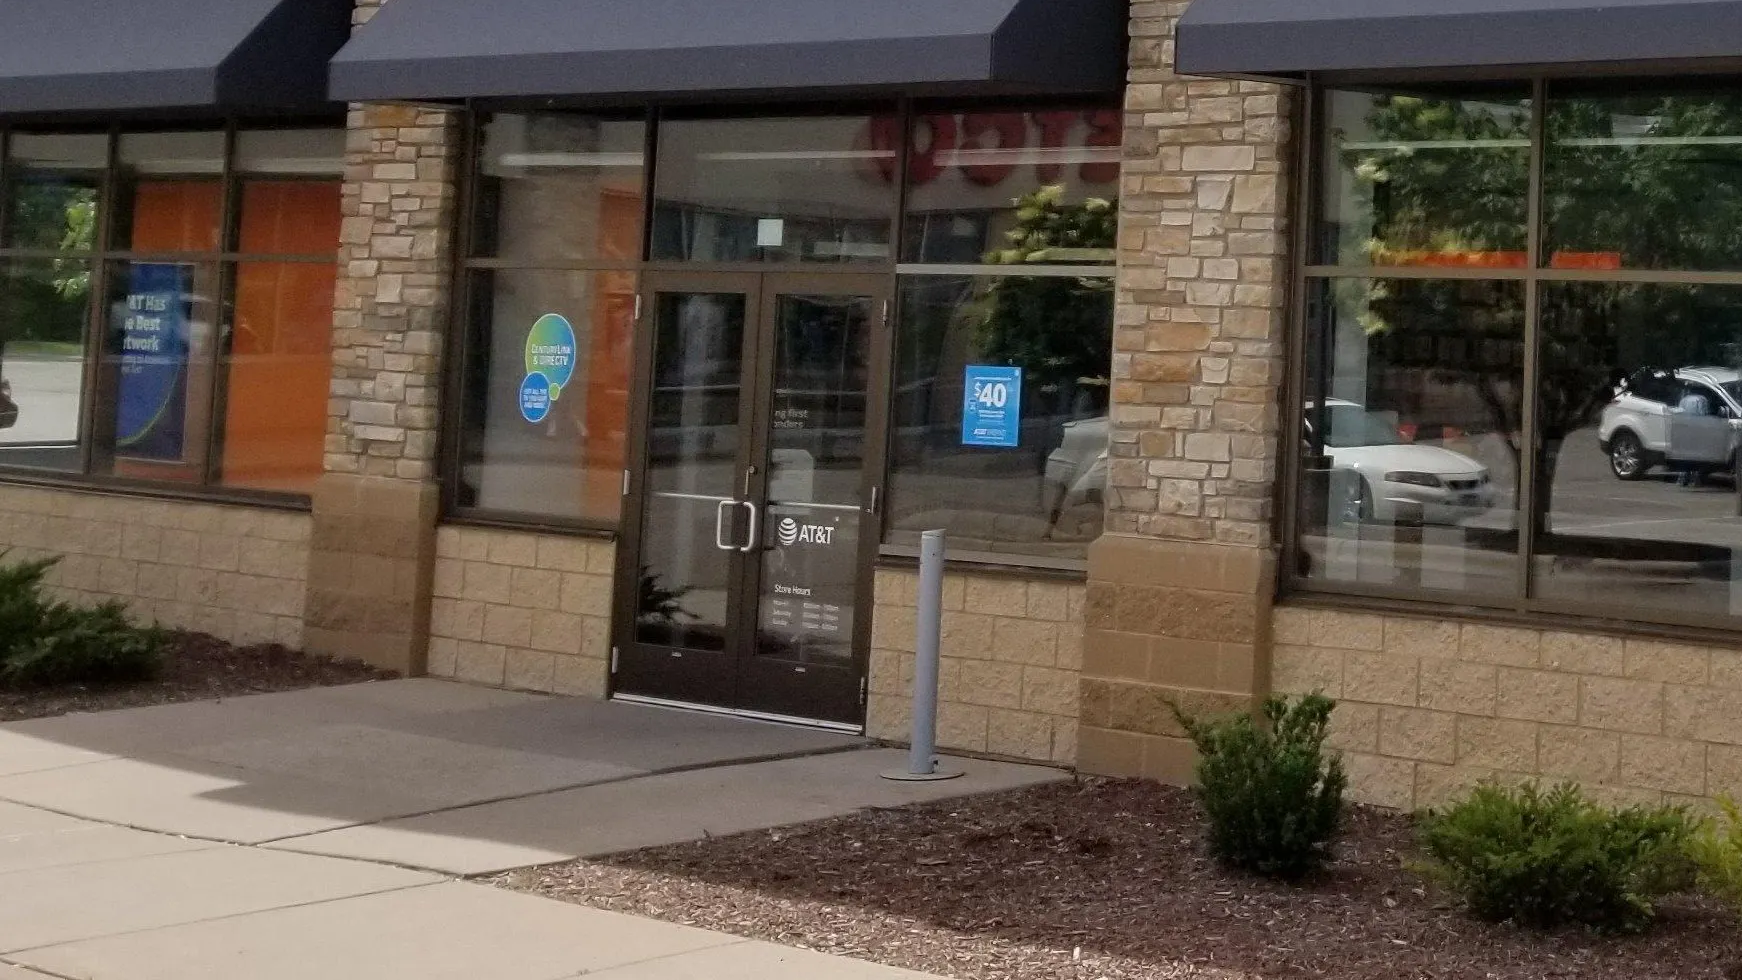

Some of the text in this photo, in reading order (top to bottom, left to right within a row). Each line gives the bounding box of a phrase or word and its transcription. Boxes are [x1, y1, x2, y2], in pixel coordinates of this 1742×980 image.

[136, 315, 160, 331] Best
[974, 381, 1007, 407] $40
[798, 524, 834, 544] AT&T
[774, 584, 811, 596] Store Hours
